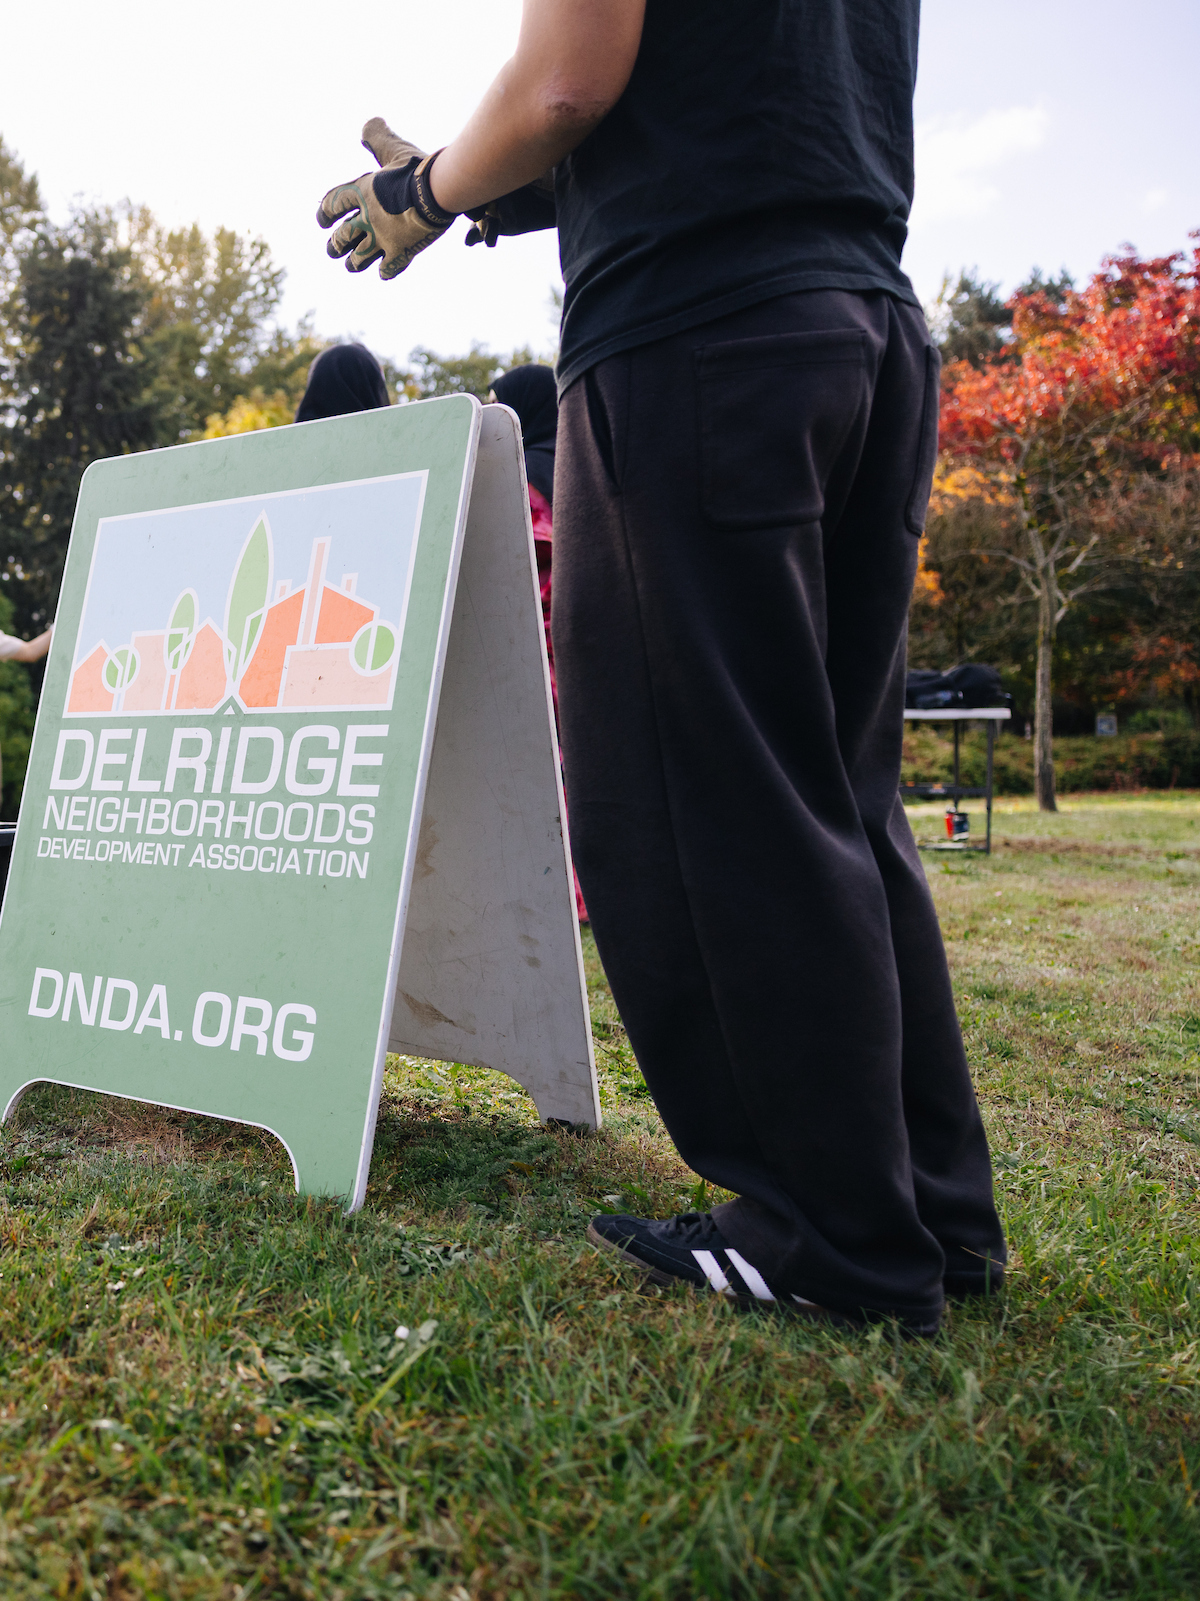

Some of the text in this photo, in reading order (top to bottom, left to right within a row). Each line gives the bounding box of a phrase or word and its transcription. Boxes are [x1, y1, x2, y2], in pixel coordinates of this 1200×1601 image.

[49, 724, 390, 797] DELRIDGE
[42, 795, 376, 845] NEIGHBORHOODS
[37, 836, 370, 879] DEVELOPMENT ASSOCIATION
[27, 967, 317, 1062] DNDA.ORG
